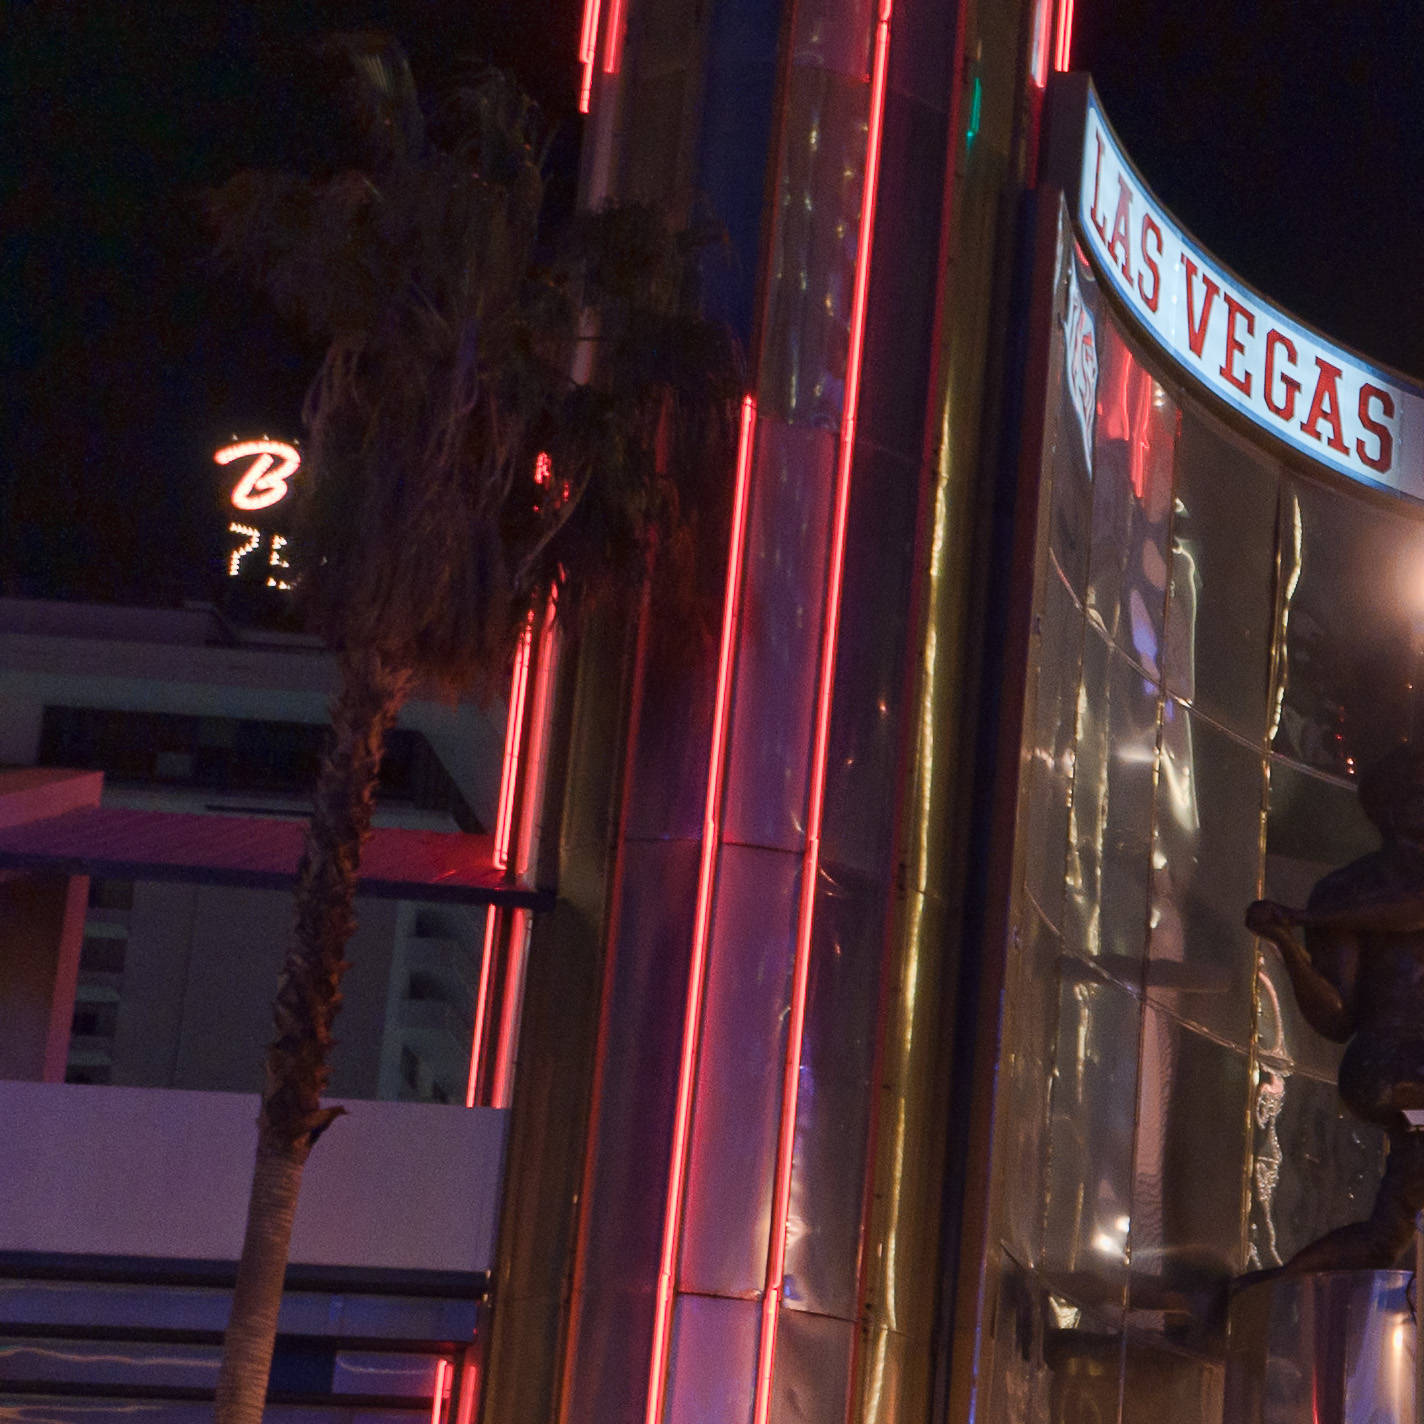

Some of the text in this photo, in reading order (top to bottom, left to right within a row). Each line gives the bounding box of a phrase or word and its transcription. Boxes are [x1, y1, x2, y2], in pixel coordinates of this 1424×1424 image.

[1089, 127, 1167, 315] LAS
[1179, 250, 1395, 474] VEGAS
[213, 438, 302, 511] B
